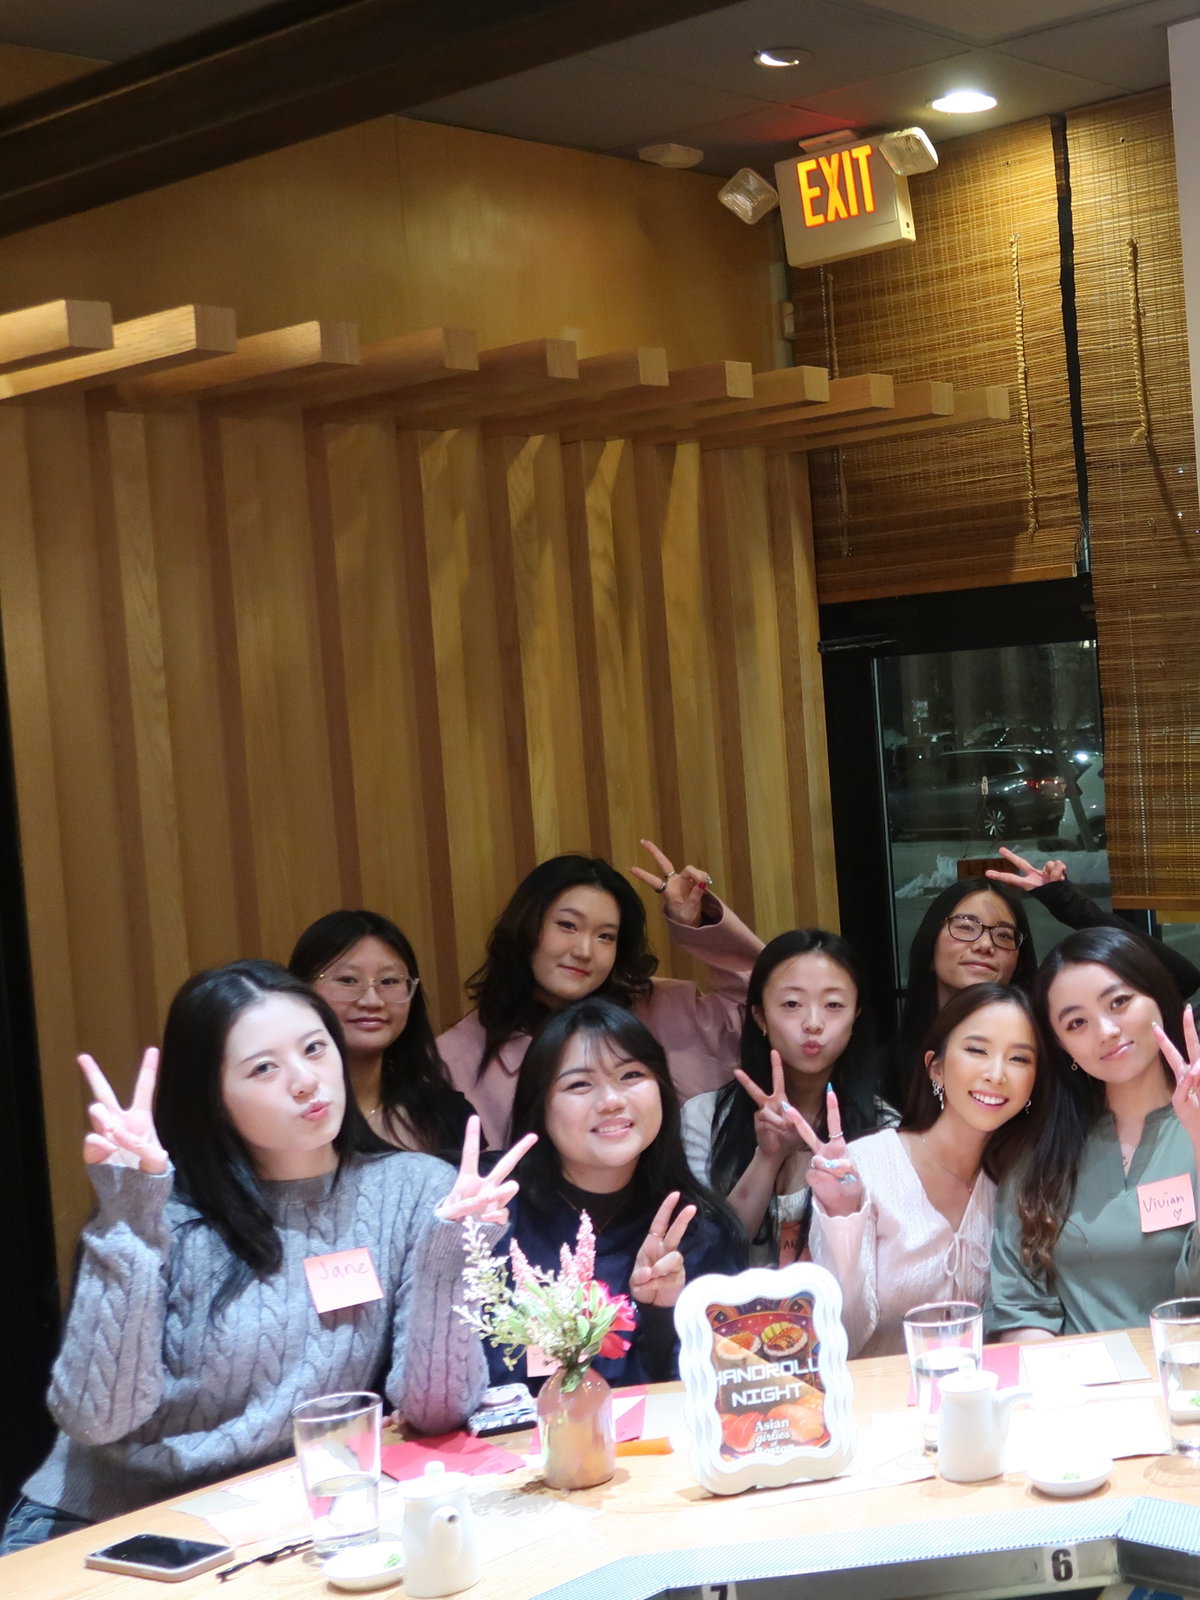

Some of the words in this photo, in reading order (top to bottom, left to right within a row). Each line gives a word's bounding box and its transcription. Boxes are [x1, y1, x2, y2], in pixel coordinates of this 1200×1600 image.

[797, 145, 875, 228] EXIT
[1143, 1192, 1184, 1213] Vivian
[319, 1262, 369, 1280] Jane
[732, 1383, 803, 1407] NIGHT
[755, 1418, 789, 1432] Asian
[755, 1429, 791, 1447] girlies
[1051, 1549, 1074, 1582] 6
